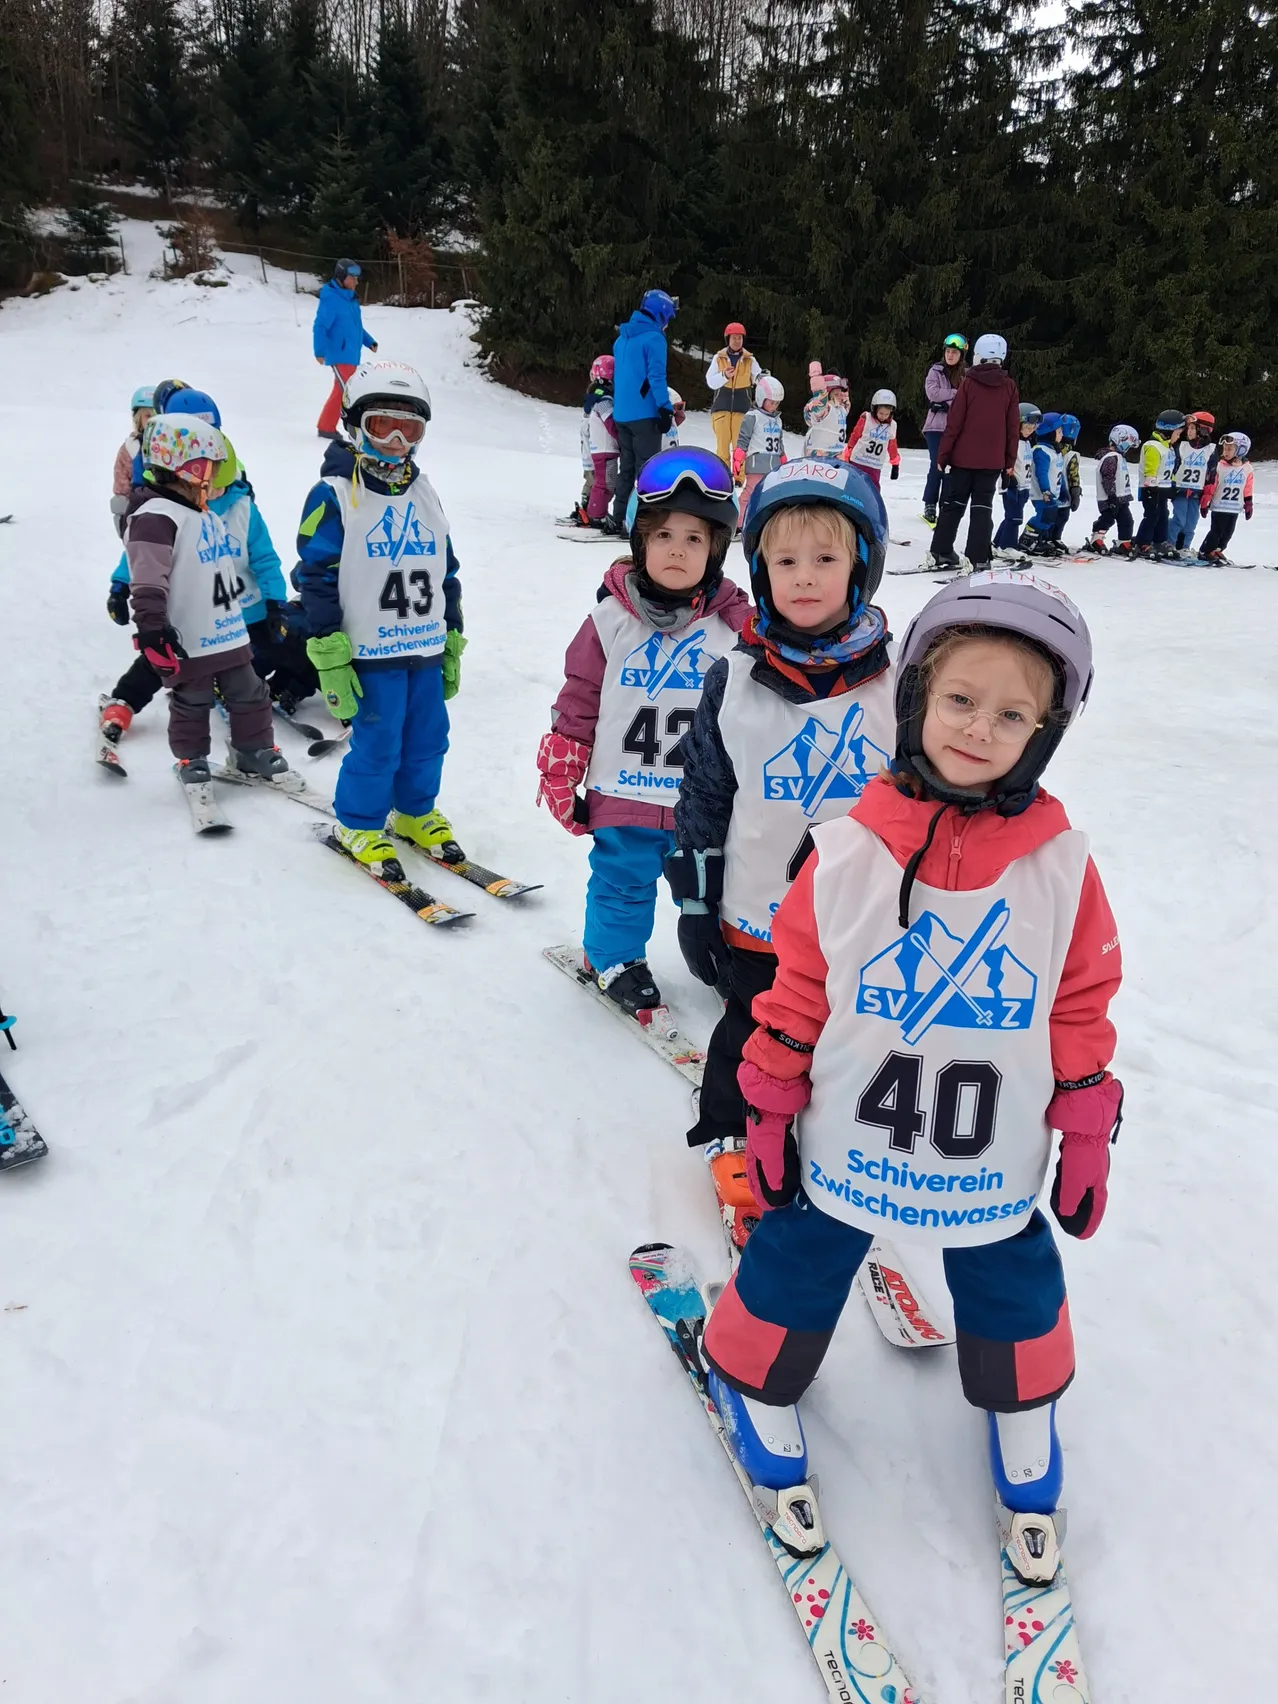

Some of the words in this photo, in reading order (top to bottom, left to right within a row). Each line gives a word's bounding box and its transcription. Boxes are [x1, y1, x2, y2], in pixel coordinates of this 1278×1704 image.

[765, 437, 780, 453] 33
[866, 440, 883, 456] 30
[780, 463, 838, 480] JARO
[1182, 469, 1201, 483] 23
[1222, 487, 1240, 501] 22
[371, 542, 391, 556] SV
[379, 569, 434, 619] 43
[378, 620, 440, 638] Schiverein
[625, 669, 651, 686] SV
[622, 706, 697, 767] 42
[770, 778, 804, 799] SV
[863, 988, 908, 1022] SV
[1002, 1001, 1022, 1028] Z
[855, 1050, 1003, 1159] 40
[847, 1149, 1003, 1193] Schiverein
[810, 1160, 1037, 1228] Zwischenwasser
[868, 1261, 885, 1294] RACE
[879, 1265, 946, 1340] ATOMIC
[824, 1650, 853, 1704] Tecno
